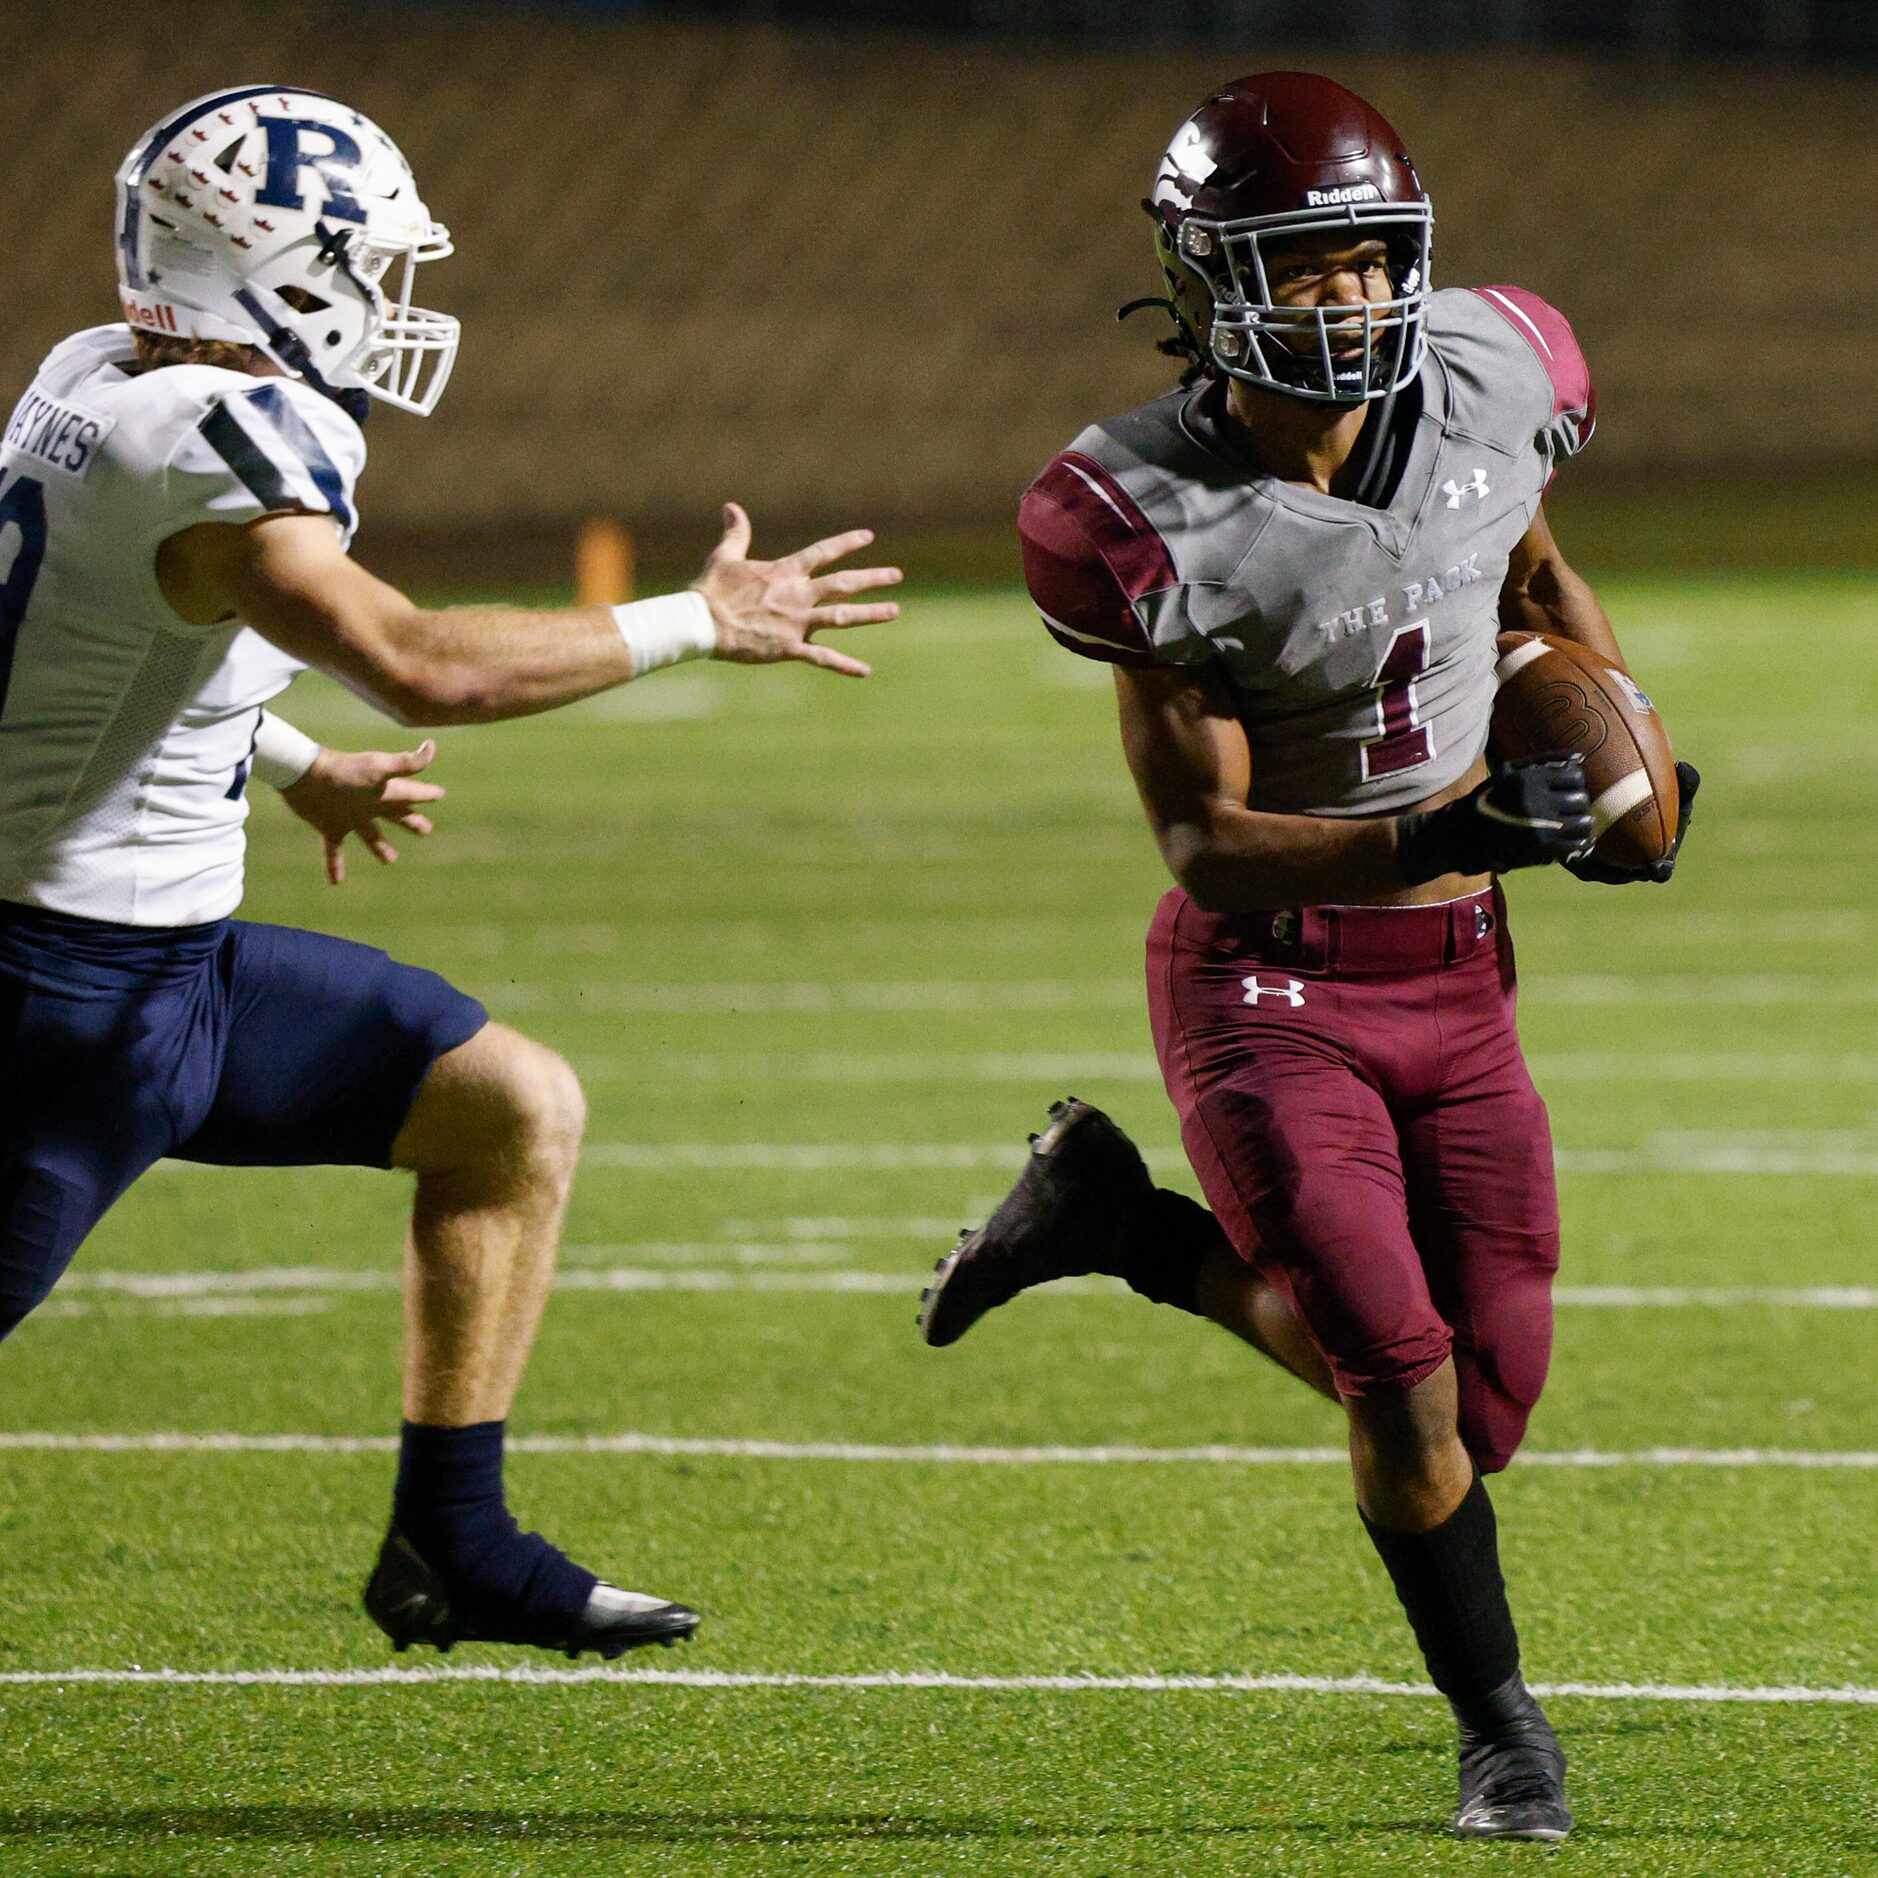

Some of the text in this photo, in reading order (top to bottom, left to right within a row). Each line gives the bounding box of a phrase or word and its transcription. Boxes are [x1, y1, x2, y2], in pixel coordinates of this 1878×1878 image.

[255, 116, 368, 225] R
[1307, 184, 1376, 207] Riddell
[1333, 371, 1363, 381] iddell
[8, 391, 99, 473] AYNES
[1319, 552, 1482, 643] THE PACK
[1360, 617, 1437, 783] 1
